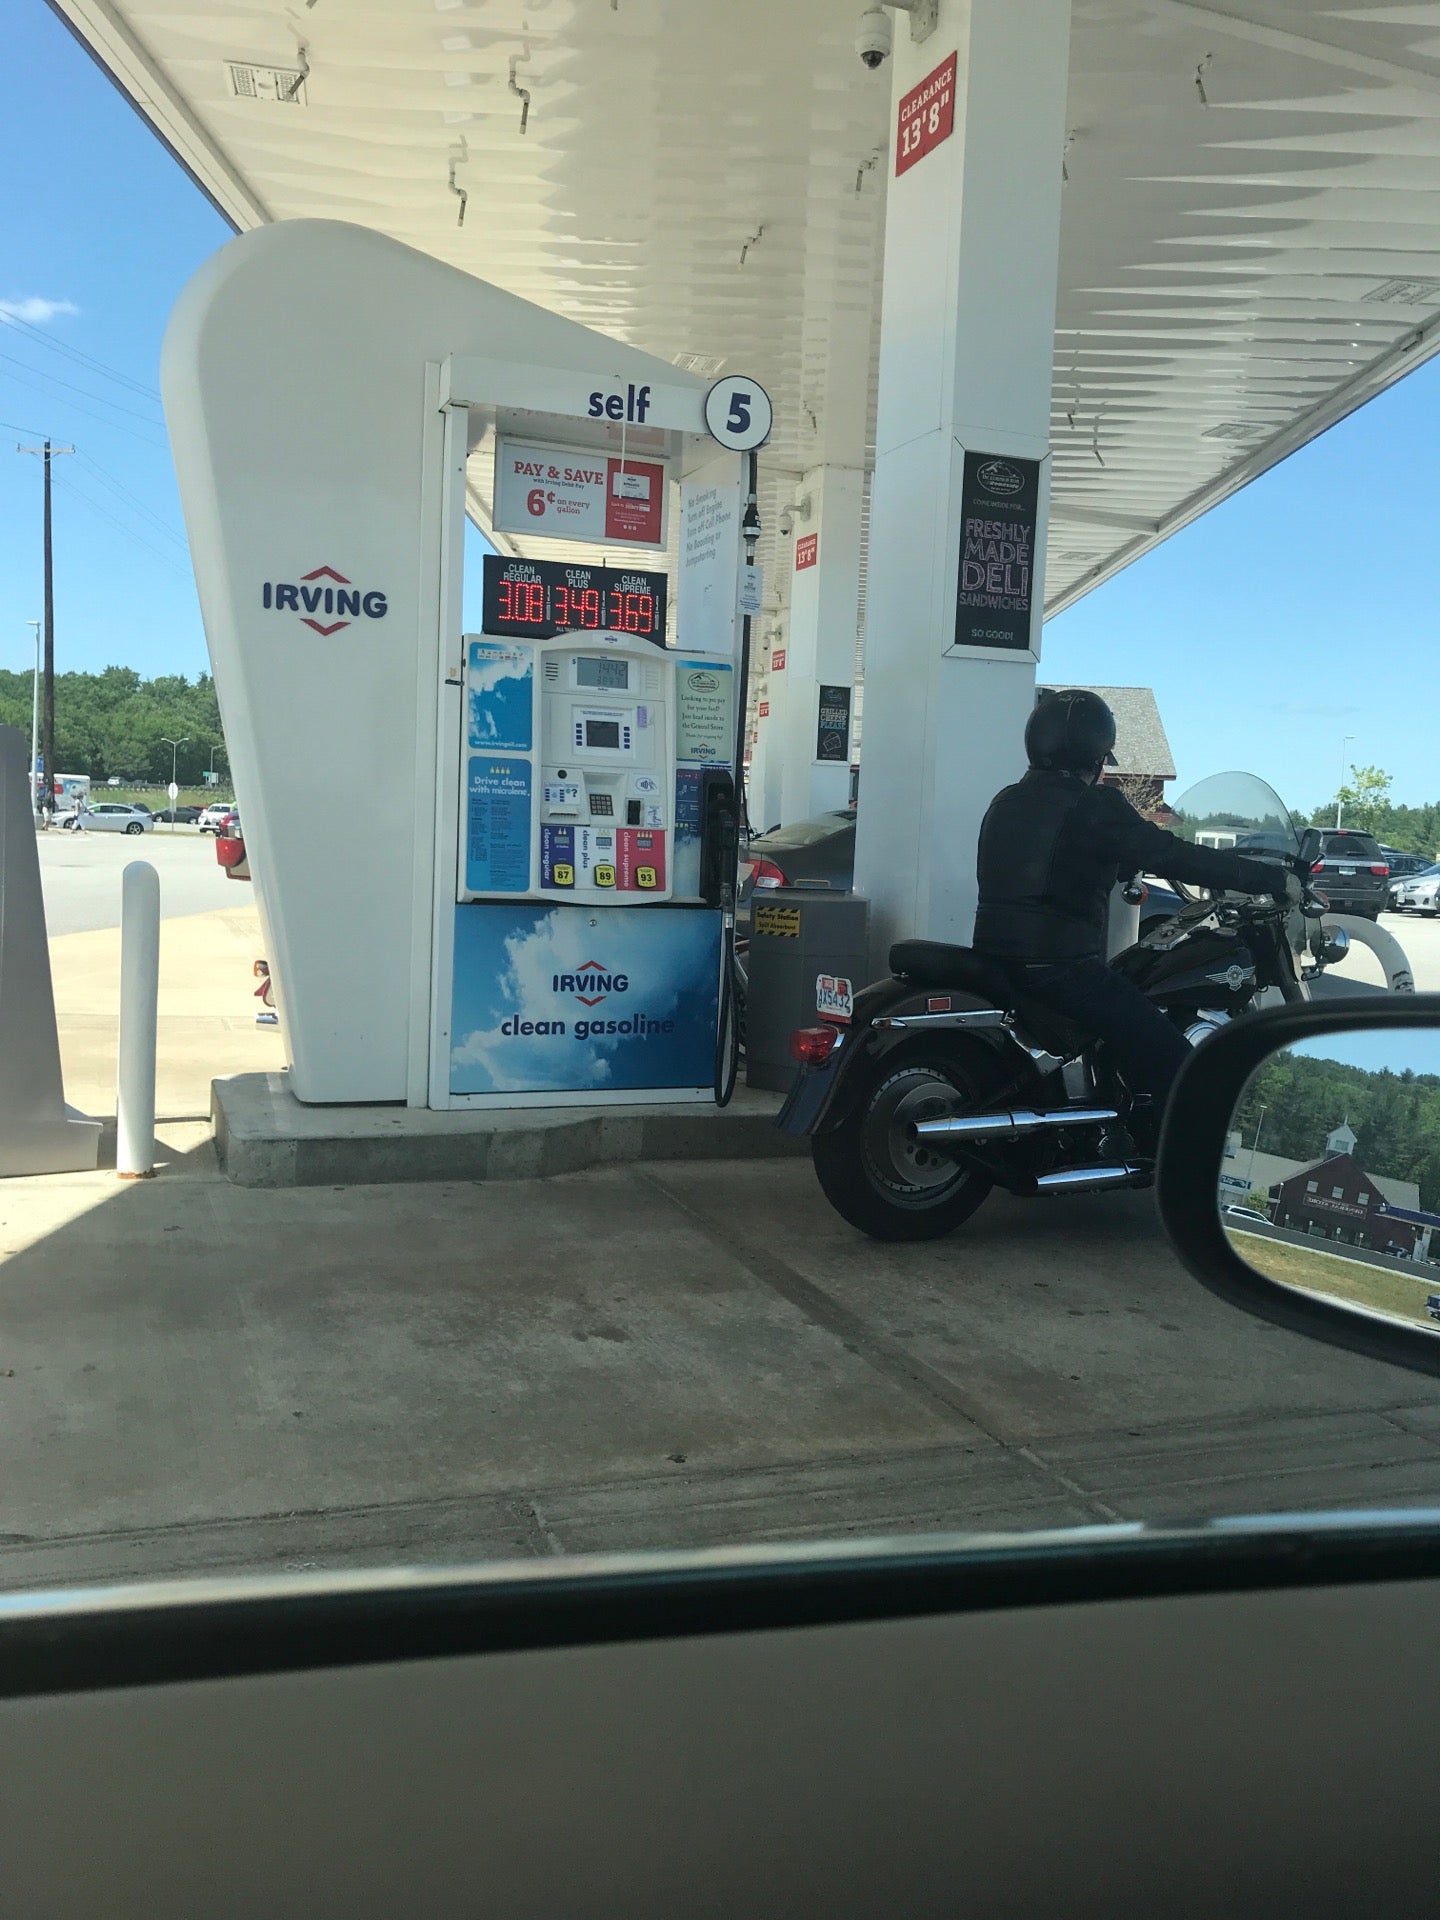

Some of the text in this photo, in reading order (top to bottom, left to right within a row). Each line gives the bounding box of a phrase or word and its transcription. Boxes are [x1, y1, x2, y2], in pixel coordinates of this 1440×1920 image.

[901, 67, 952, 121] CLEARANCE
[902, 89, 949, 157] 13'8"
[588, 384, 650, 423] self
[726, 392, 751, 433] 5
[514, 461, 604, 485] PAY & SAVE
[545, 479, 560, 487] Irving
[557, 506, 580, 514] gallon
[568, 500, 590, 510] every
[965, 518, 1030, 543] FRESHLY
[964, 537, 1029, 565] MADE
[508, 563, 535, 575] CLEAN
[565, 569, 591, 580] CLEAN
[503, 572, 542, 584] REGULAR
[567, 578, 589, 589] PLUS
[621, 575, 647, 586] CLEAN
[962, 560, 1029, 597] DELI
[614, 583, 651, 595] SUPREME
[263, 582, 388, 618] IRVING
[498, 581, 544, 622] 3.08
[959, 592, 1029, 611] SANDWICHES
[555, 586, 599, 628] 3.49
[609, 592, 653, 633] 3.69
[971, 628, 1014, 640] SO GOOD!
[821, 707, 848, 716] GRILLED
[820, 714, 846, 722] CHEESE
[820, 721, 846, 729] PLEASE
[690, 747, 716, 755] IRVING
[474, 776, 525, 787] Drive clean
[469, 785, 490, 794] with
[542, 828, 552, 880] clean regular
[581, 829, 590, 869] clean plus
[622, 831, 631, 887] clean supreme
[557, 871, 569, 879] 87
[599, 872, 611, 880] 89
[640, 873, 652, 882] 93
[757, 912, 776, 921] Safety
[552, 974, 629, 992] IRVING
[501, 1013, 675, 1040] clean gasoline
